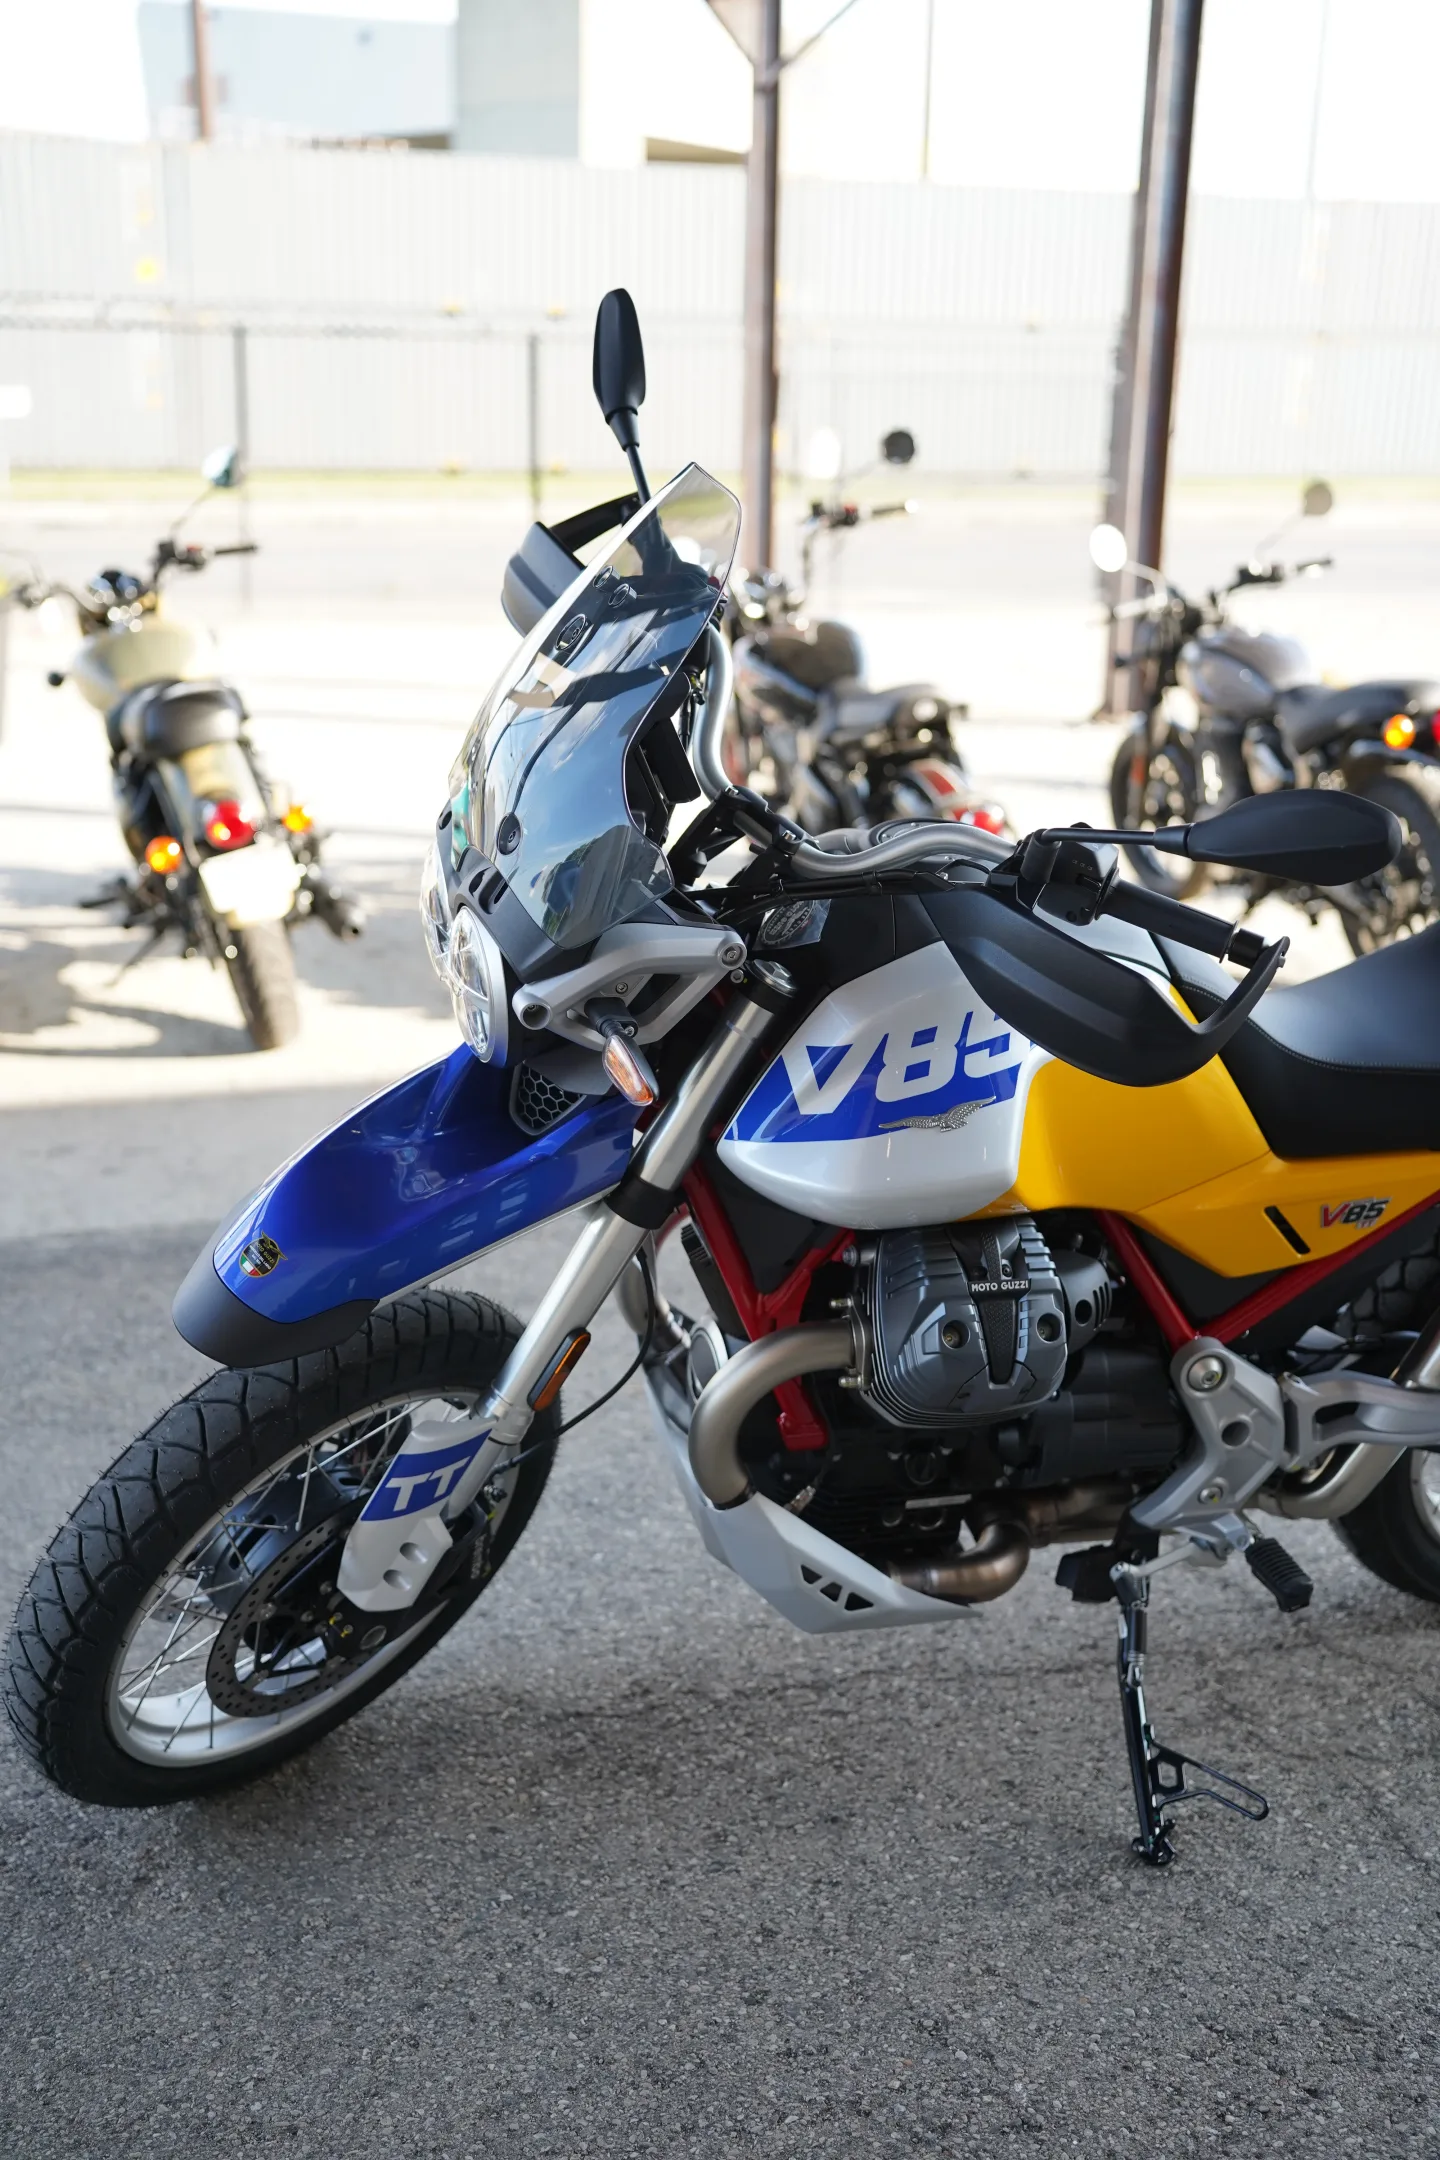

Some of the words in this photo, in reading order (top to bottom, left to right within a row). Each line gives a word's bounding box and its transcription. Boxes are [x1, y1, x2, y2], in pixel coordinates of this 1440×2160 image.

[780, 1006, 1030, 1115] V85
[1320, 1196, 1392, 1228] V85
[971, 1282, 998, 1292] MOTO
[1000, 1280, 1029, 1290] GUZZI
[385, 1456, 471, 1512] TT
